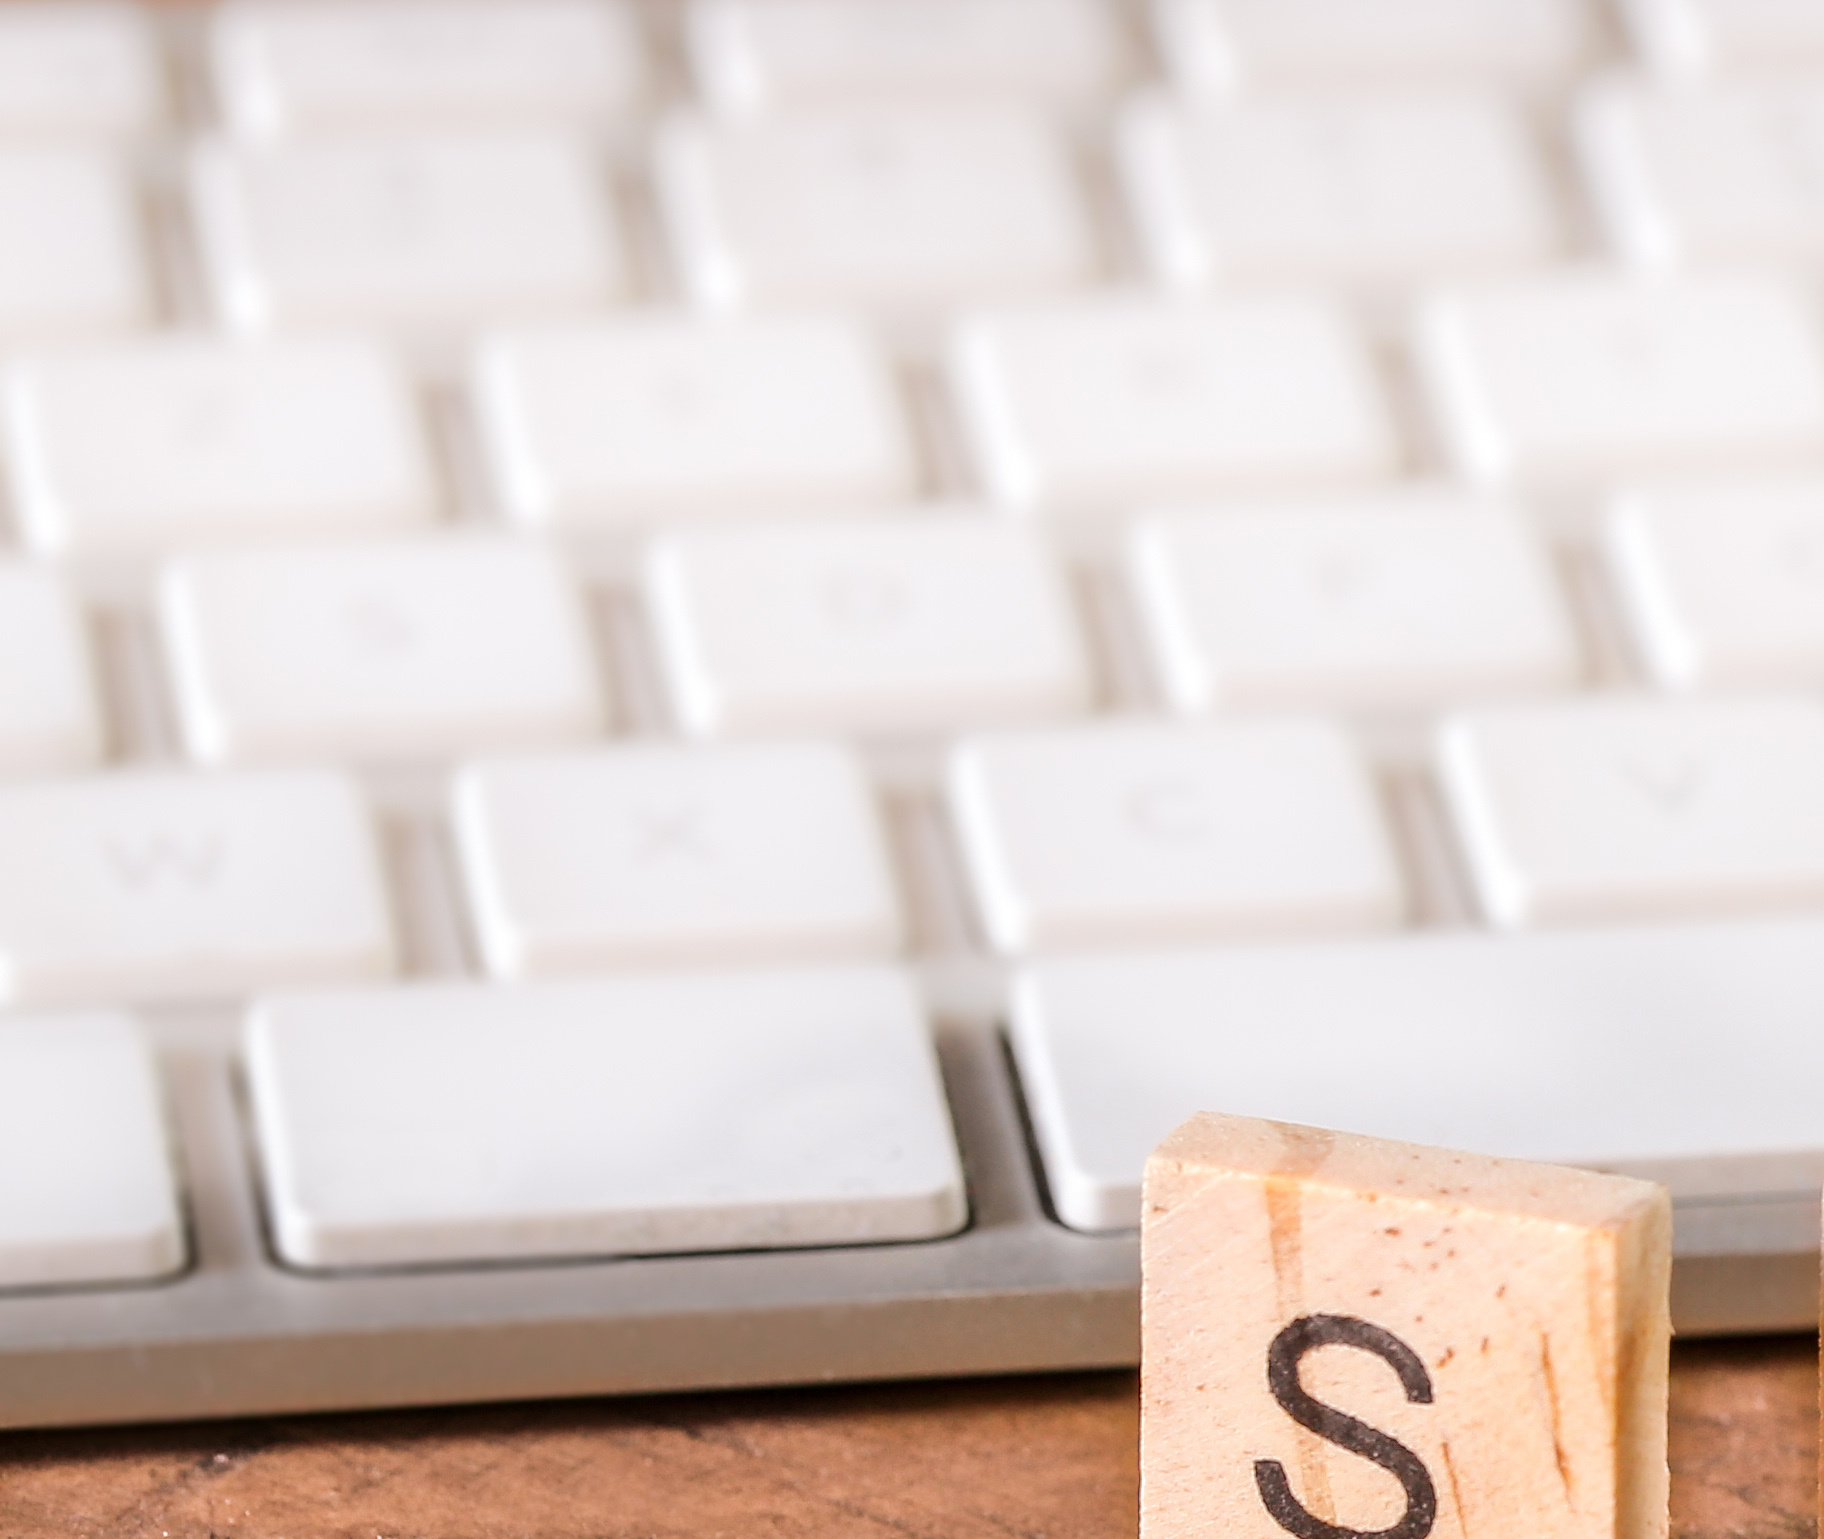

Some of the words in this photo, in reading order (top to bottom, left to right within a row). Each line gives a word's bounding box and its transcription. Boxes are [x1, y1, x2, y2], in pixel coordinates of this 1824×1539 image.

[633, 803, 714, 864] X
[1118, 779, 1206, 844] C
[101, 831, 226, 894] W
